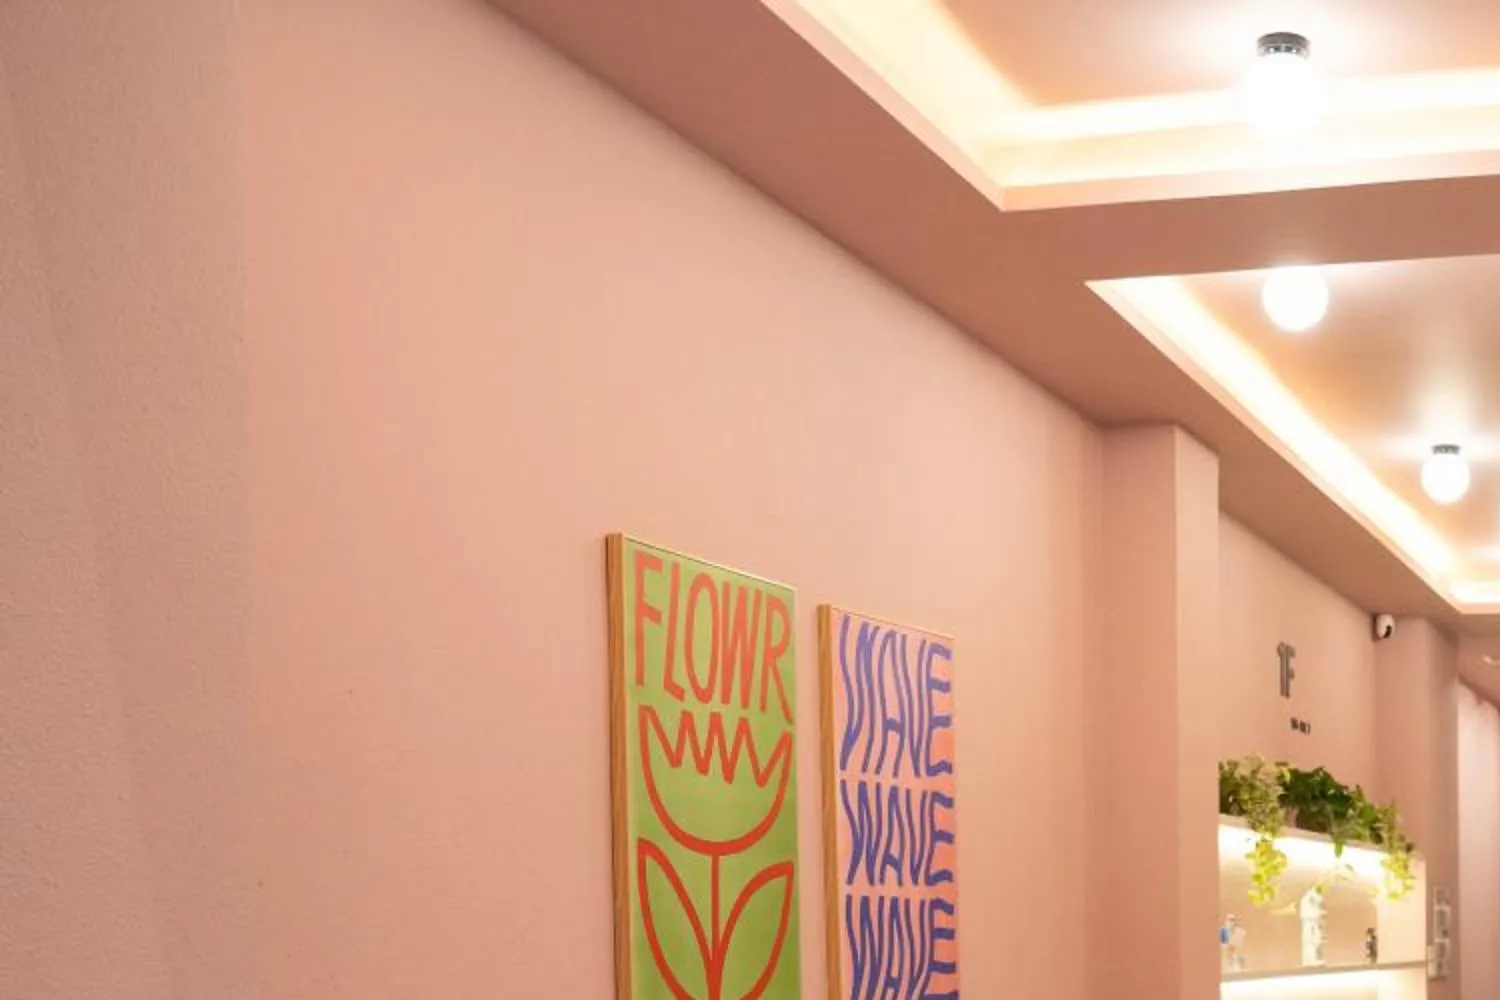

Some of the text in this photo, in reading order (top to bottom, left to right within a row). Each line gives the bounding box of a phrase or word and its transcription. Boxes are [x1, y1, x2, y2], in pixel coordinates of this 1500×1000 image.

[635, 551, 793, 724] FLOWR
[840, 613, 953, 777] WAVE
[840, 780, 954, 887] WAVE
